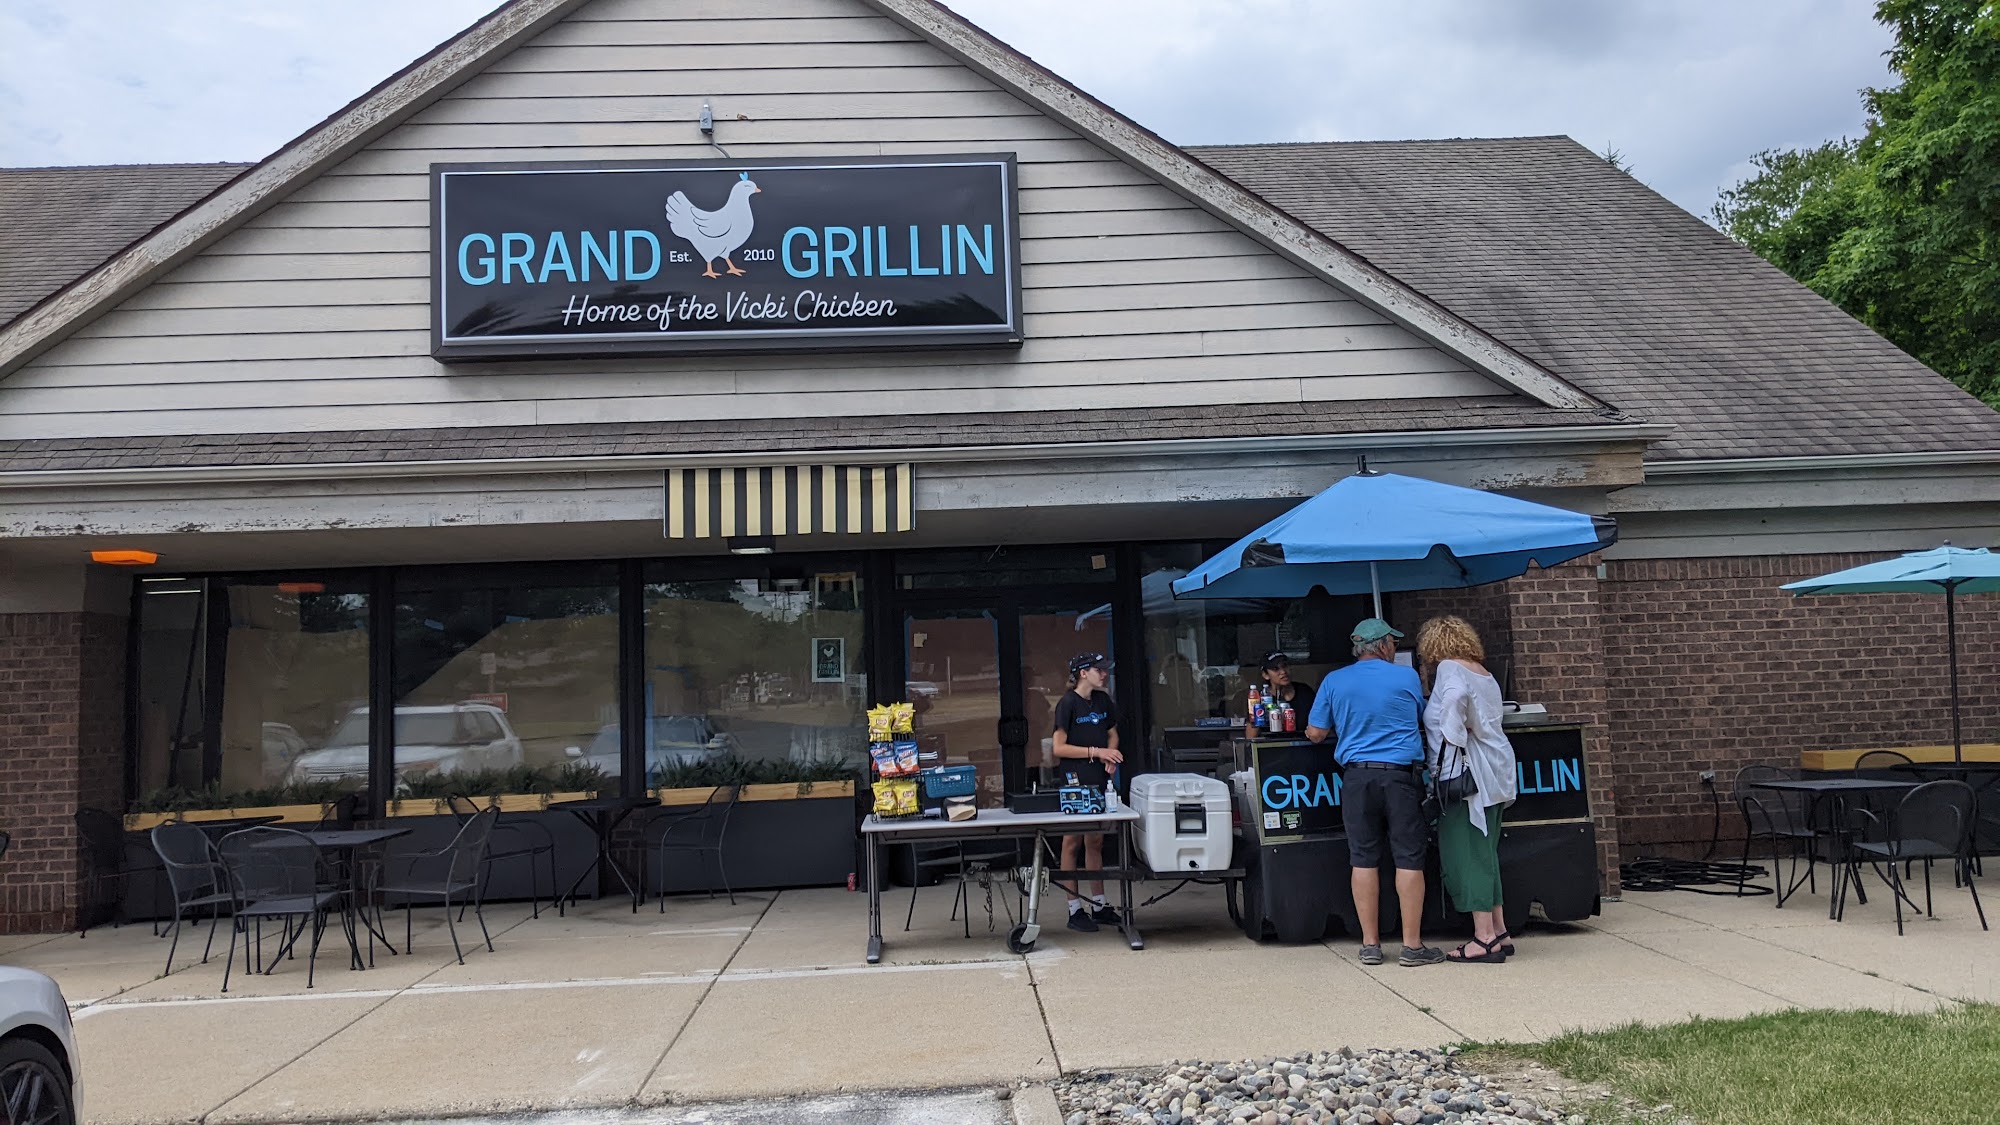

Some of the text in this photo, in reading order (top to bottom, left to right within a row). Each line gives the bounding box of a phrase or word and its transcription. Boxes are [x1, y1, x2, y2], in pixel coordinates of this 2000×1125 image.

[457, 224, 994, 286] GRAND Est. 2010 GRILLIN
[561, 289, 898, 331] Home of the Vicki Chicken
[1515, 758, 1581, 795] LLIN
